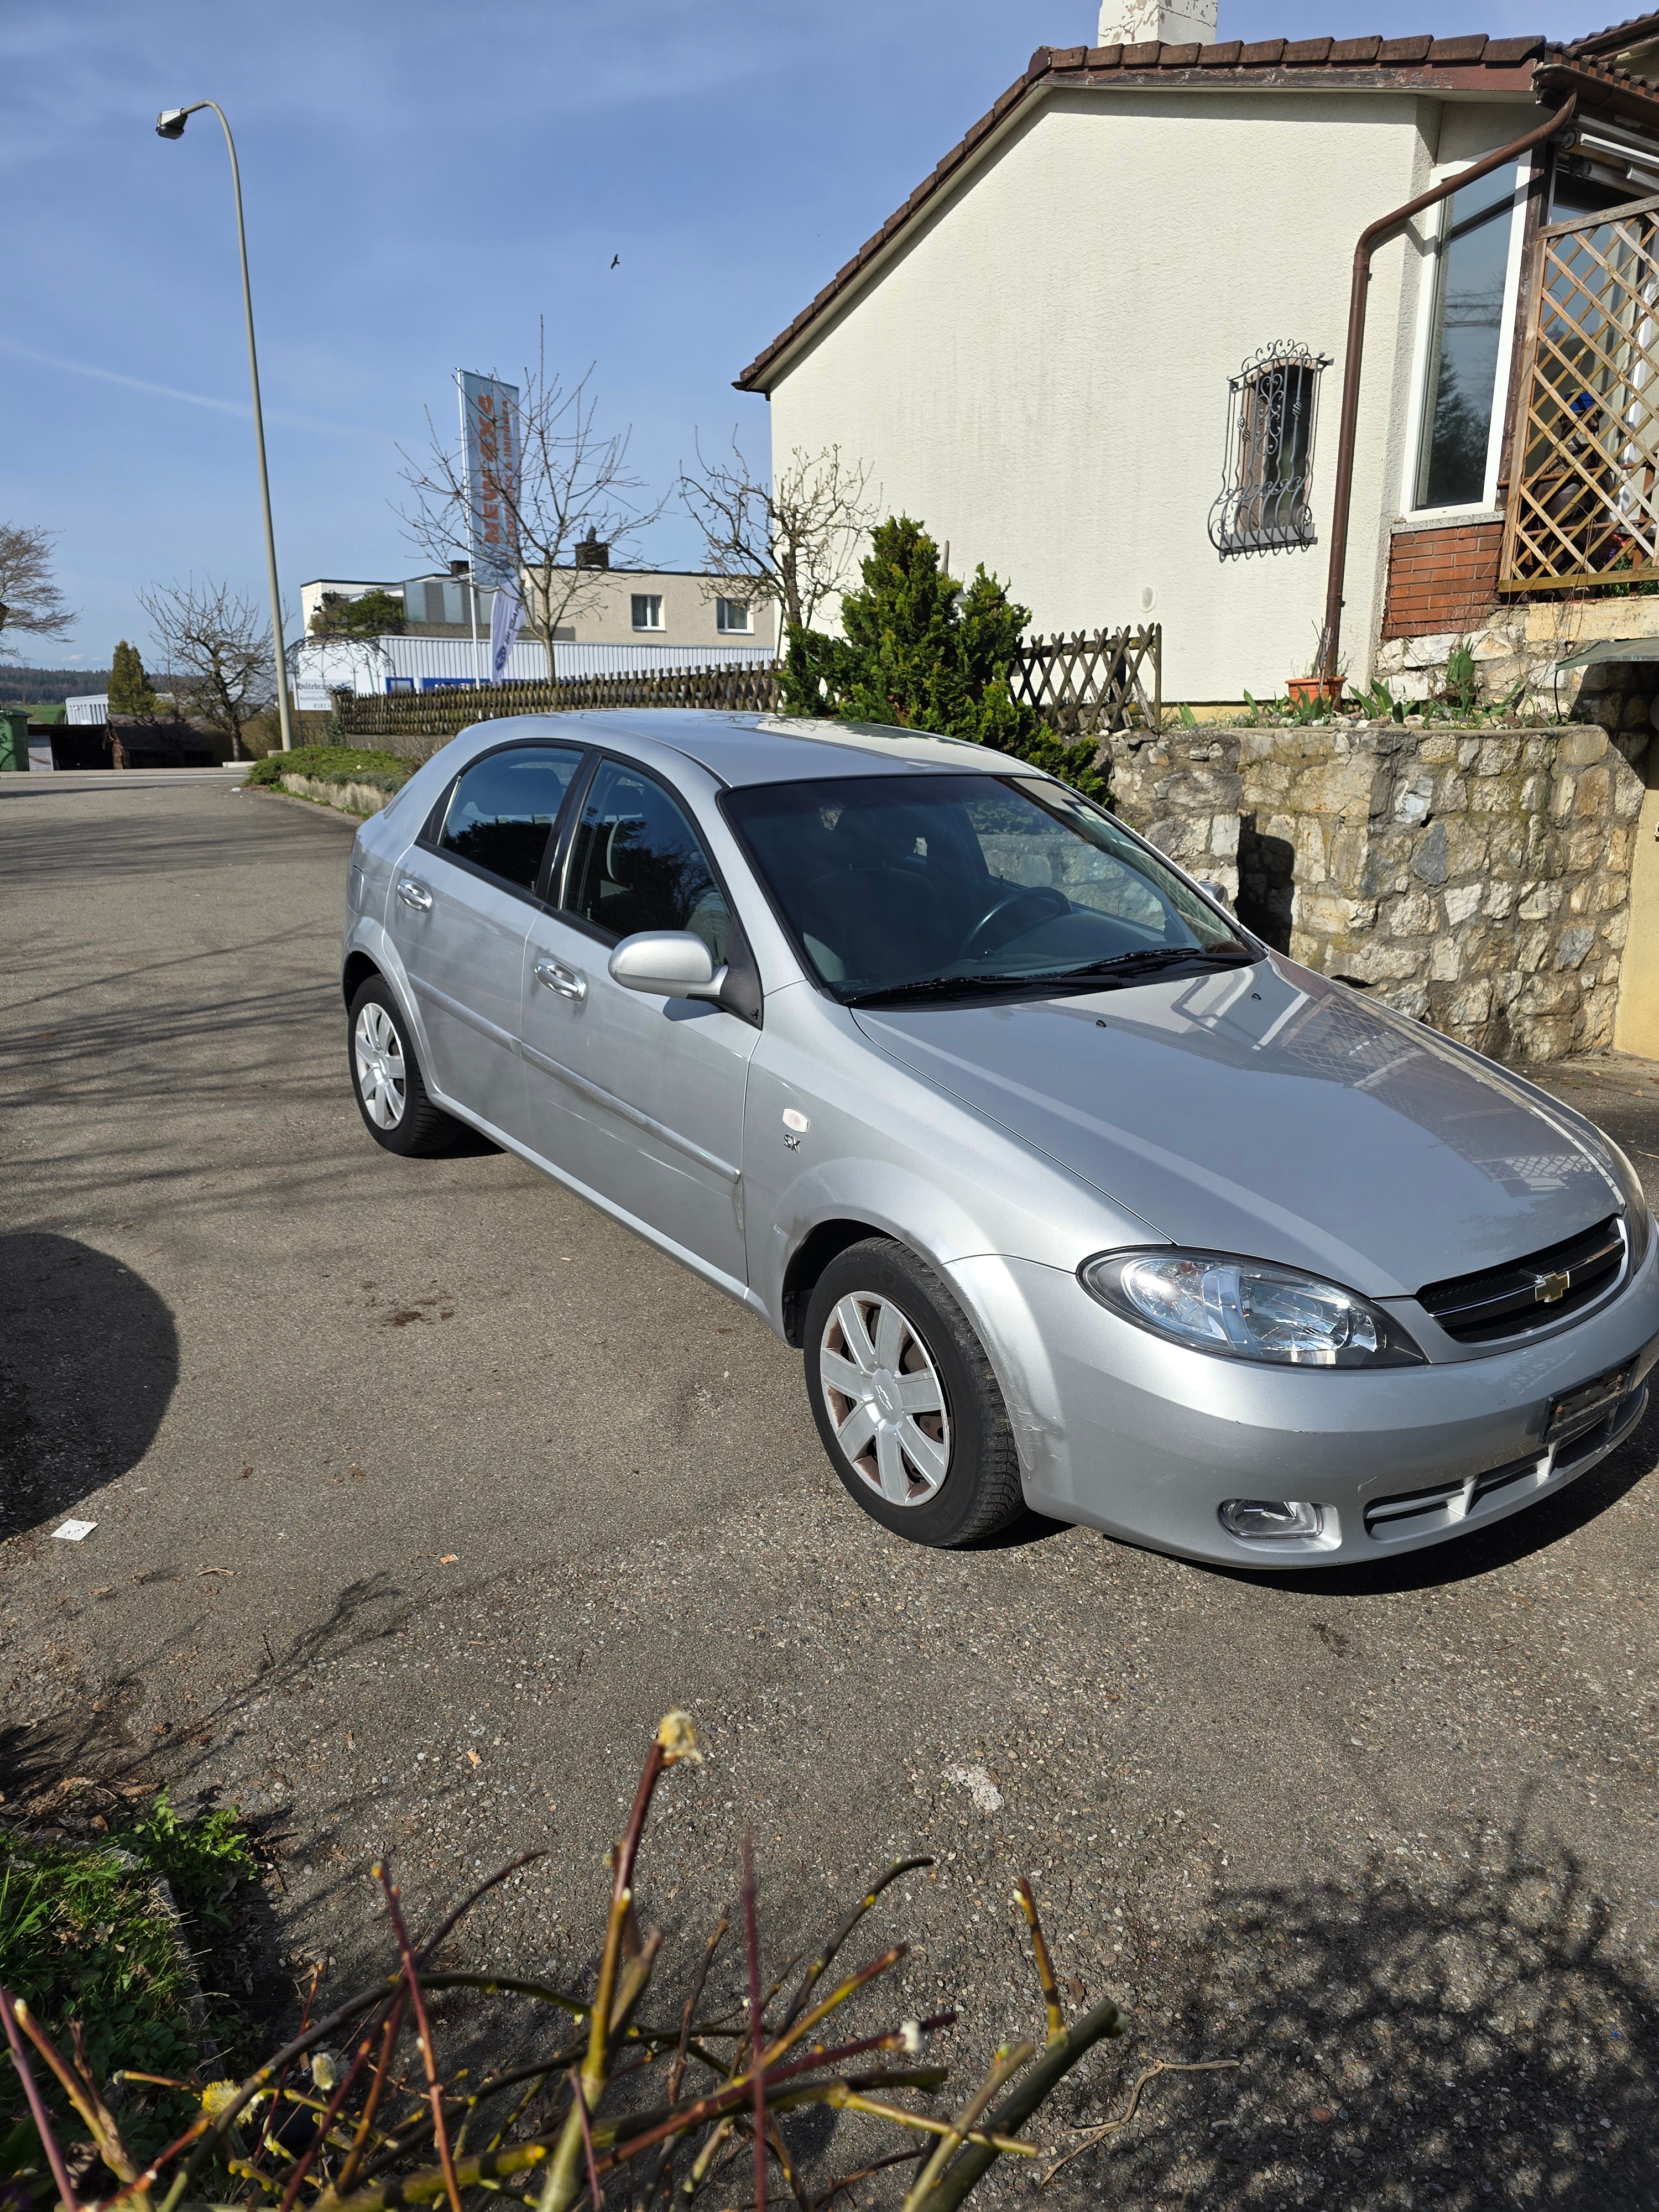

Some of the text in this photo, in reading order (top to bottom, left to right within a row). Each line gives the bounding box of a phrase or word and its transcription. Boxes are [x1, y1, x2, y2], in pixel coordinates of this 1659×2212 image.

[502, 400, 512, 457] IMPREZA
[482, 469, 500, 543] NEW
[784, 1134, 801, 1154] SX
